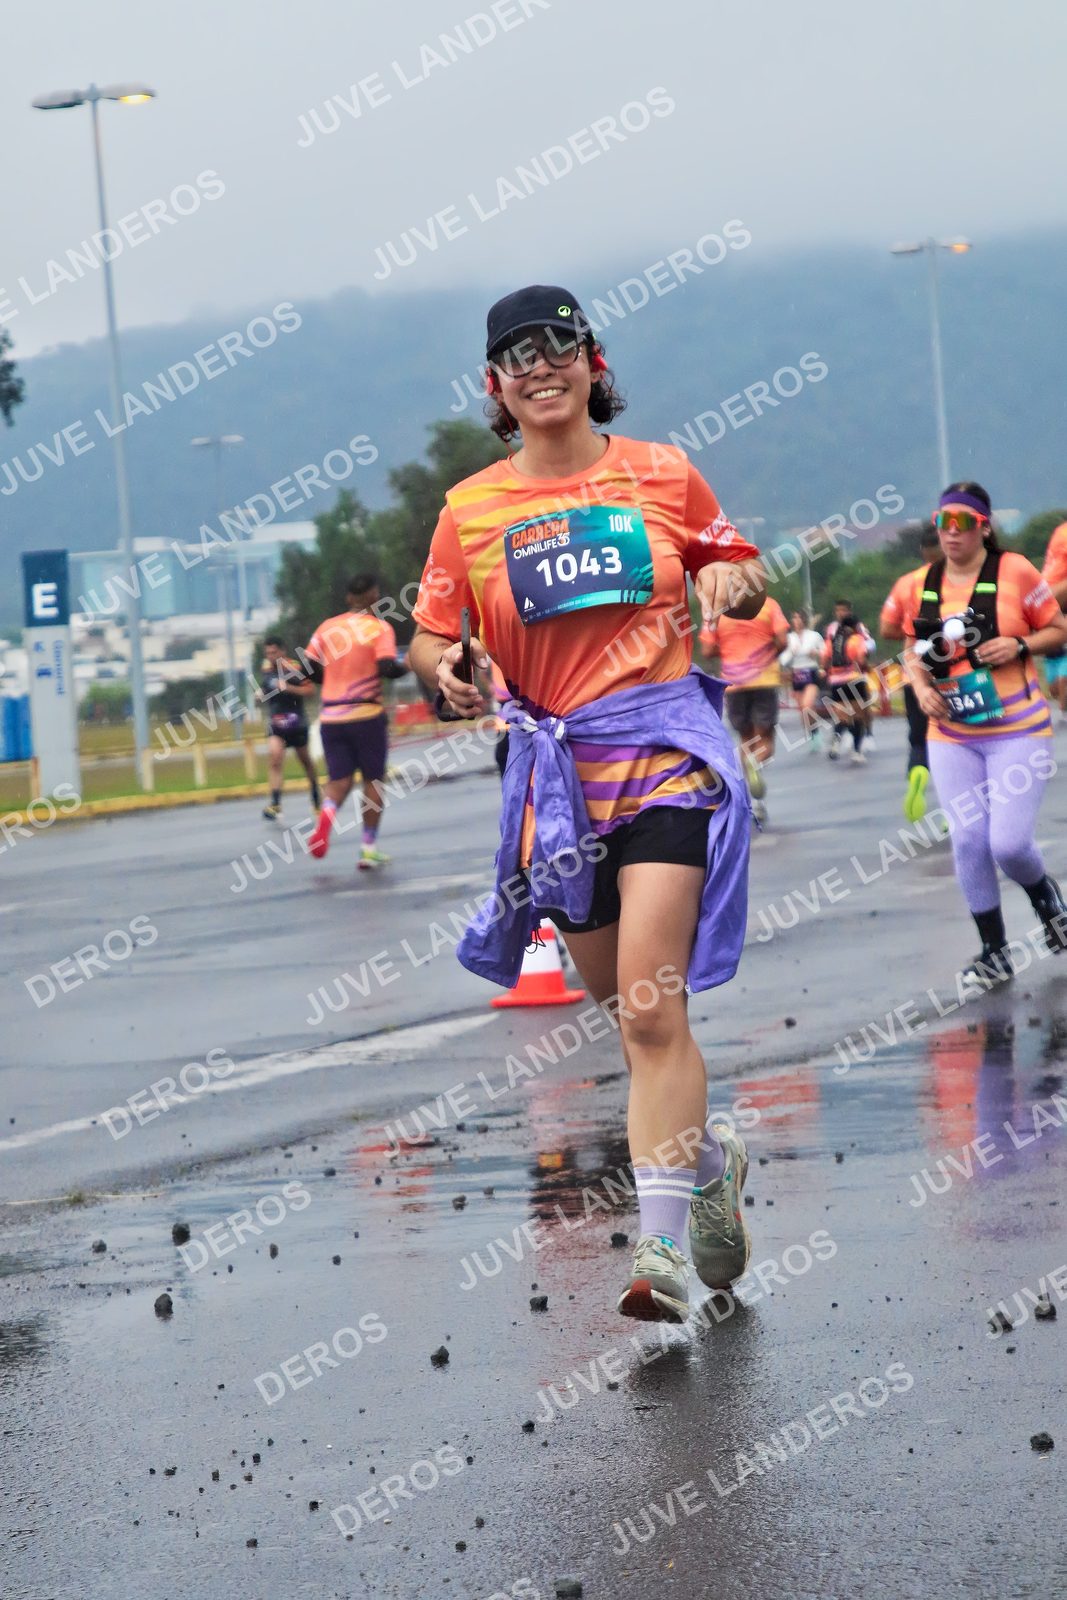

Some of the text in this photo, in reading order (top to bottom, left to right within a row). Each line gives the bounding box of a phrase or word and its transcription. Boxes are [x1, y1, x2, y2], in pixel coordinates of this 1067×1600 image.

[608, 513, 634, 533] 10K
[513, 538, 558, 559] OMNILIFE
[535, 546, 622, 587] 1043
[32, 582, 60, 618] E
